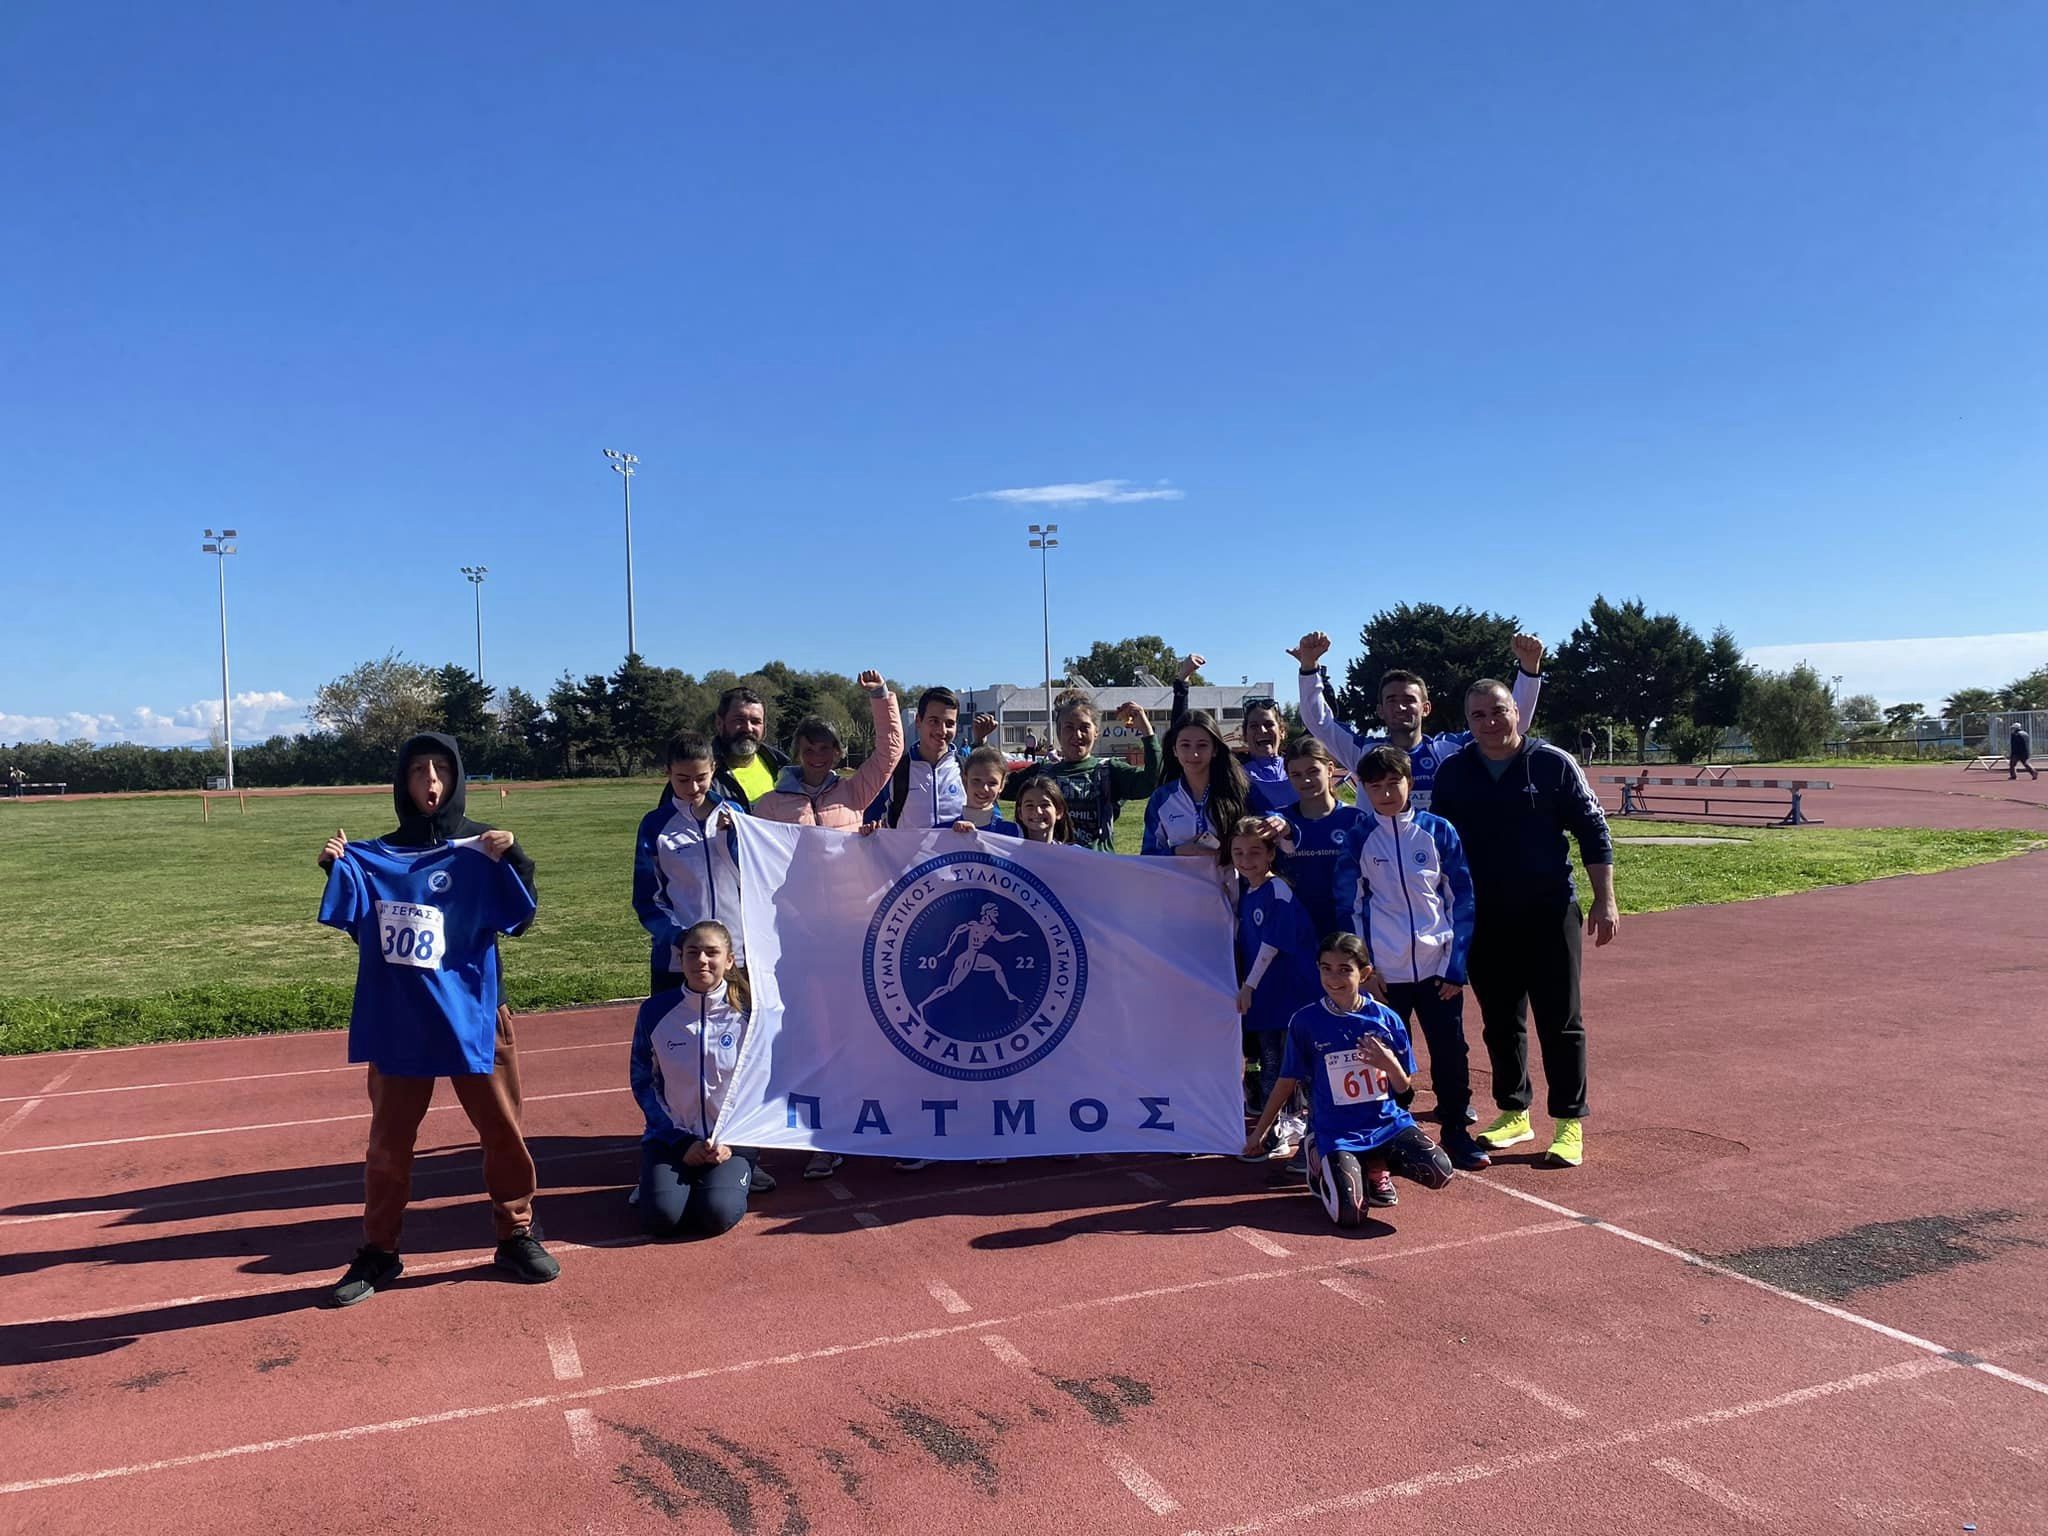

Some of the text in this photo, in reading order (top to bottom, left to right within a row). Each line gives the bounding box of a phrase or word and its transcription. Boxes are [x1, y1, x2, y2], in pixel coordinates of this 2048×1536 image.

[391, 905, 433, 919] ΣΕΓΑΣ
[383, 925, 435, 961] 308
[879, 867, 1070, 1000] ΓΥΜΝΑΣΤΙΚΟΣ ΣΥΛΛΟΓΟΣ ΠΑΤΜΟΥ
[917, 955, 1035, 969] 20 22
[897, 1011, 1054, 1064] ΣΤΑΔΙΟΝ
[786, 1091, 1176, 1137] ΠΑΤΜΟΣ
